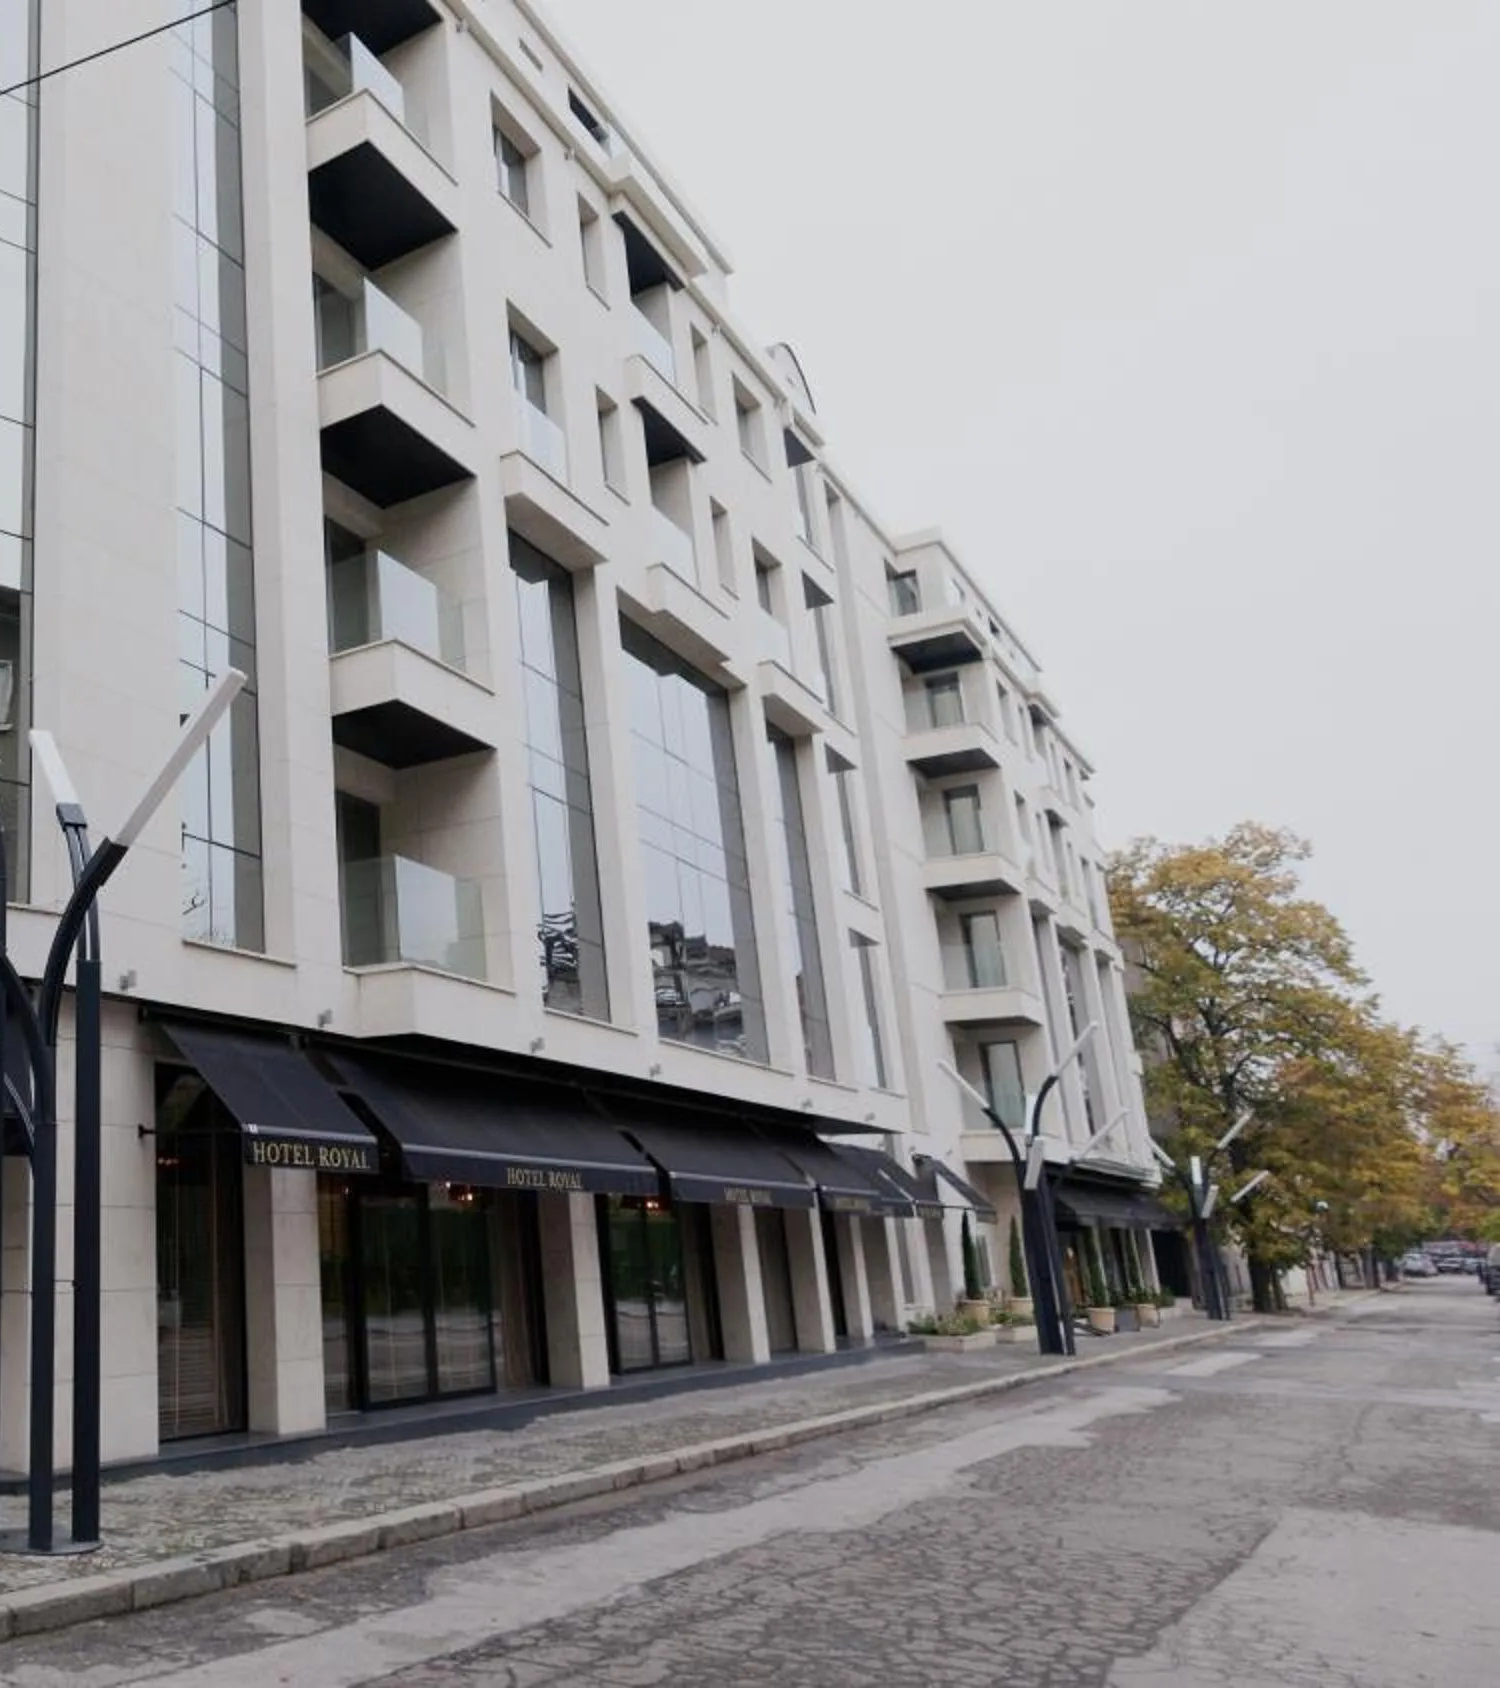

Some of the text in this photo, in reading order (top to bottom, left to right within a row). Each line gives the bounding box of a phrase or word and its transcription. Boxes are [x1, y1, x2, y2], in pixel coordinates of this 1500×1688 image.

[253, 1141, 371, 1169] HOTEL ROYAL
[506, 1167, 547, 1187] HOTEL
